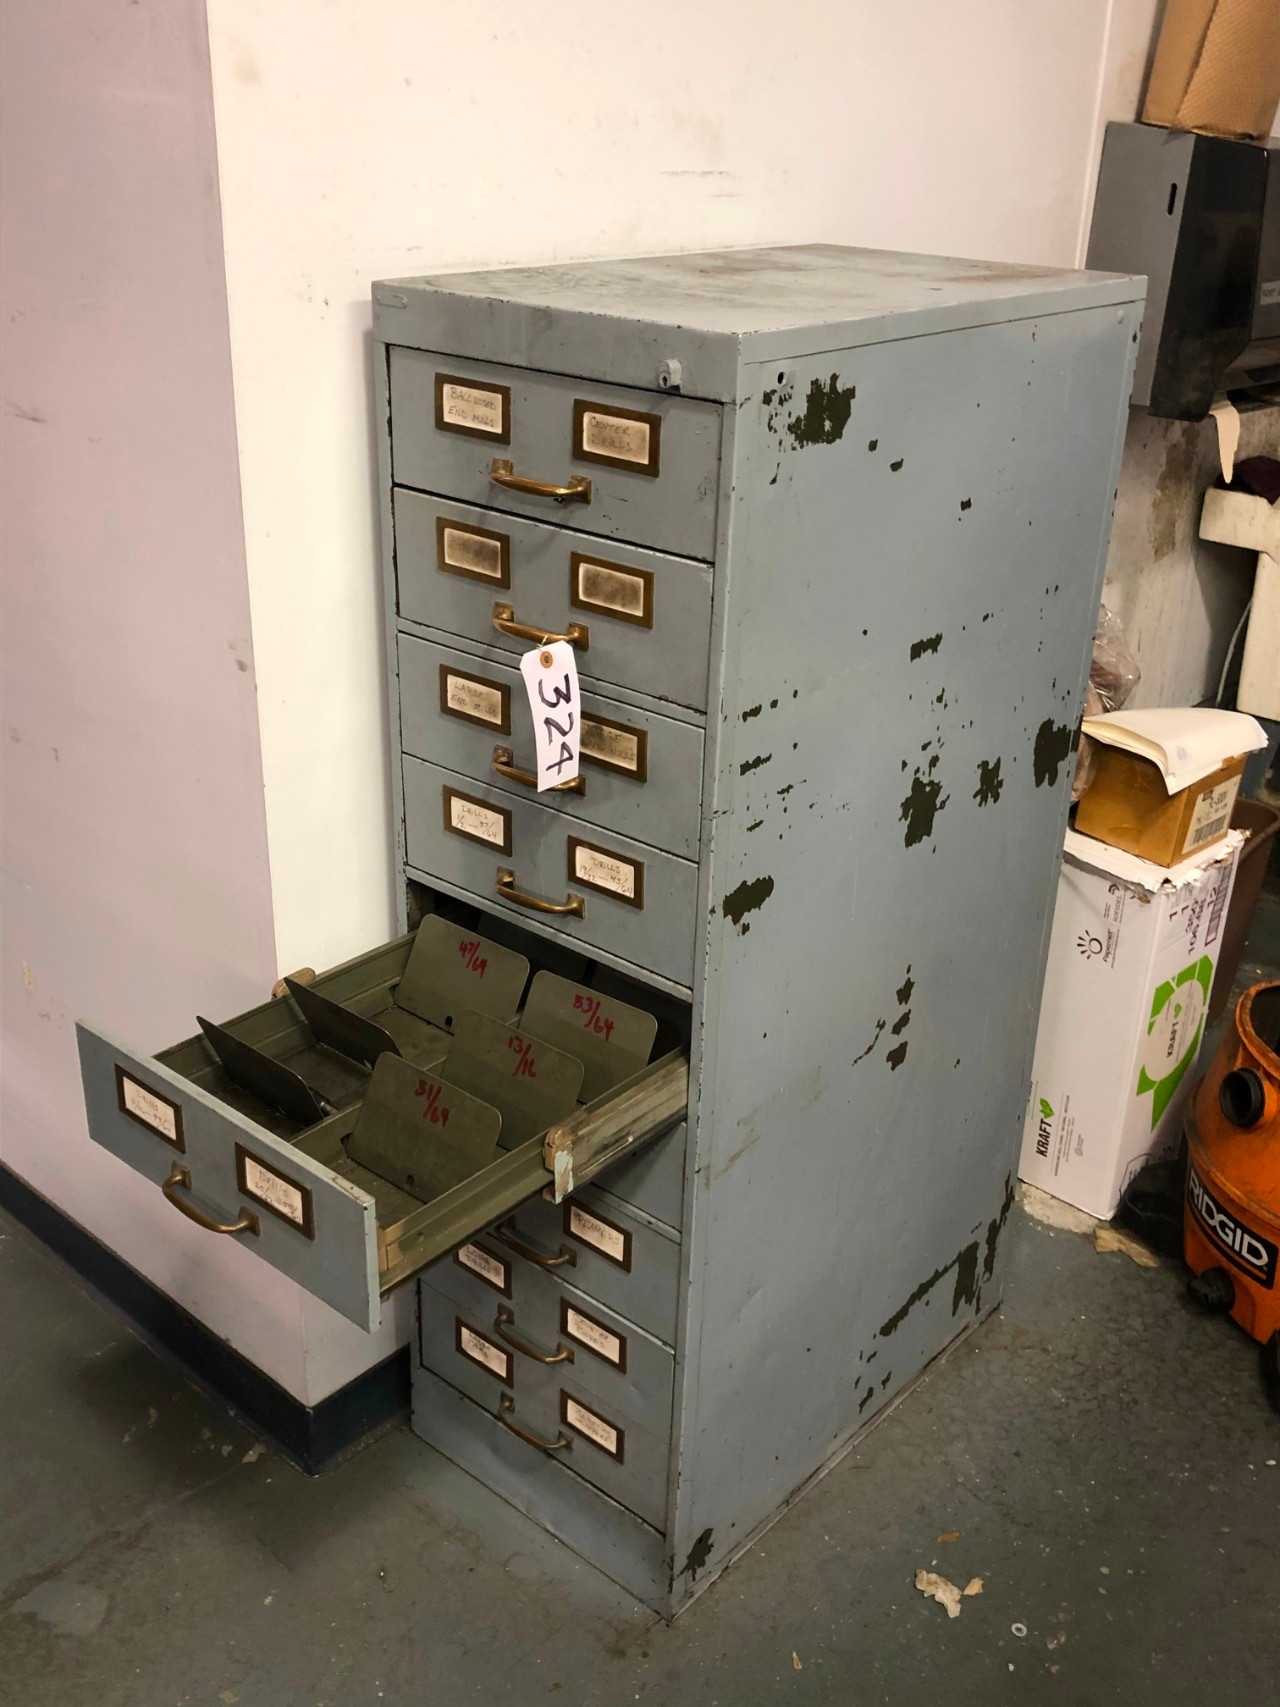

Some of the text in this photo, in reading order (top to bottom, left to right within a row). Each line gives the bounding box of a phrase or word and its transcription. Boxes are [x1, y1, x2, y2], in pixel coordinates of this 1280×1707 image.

[538, 672, 574, 776] 324
[572, 993, 615, 1042] 53/64
[1036, 1118, 1053, 1157] KRAFT
[1188, 1168, 1270, 1267] RIDGID
